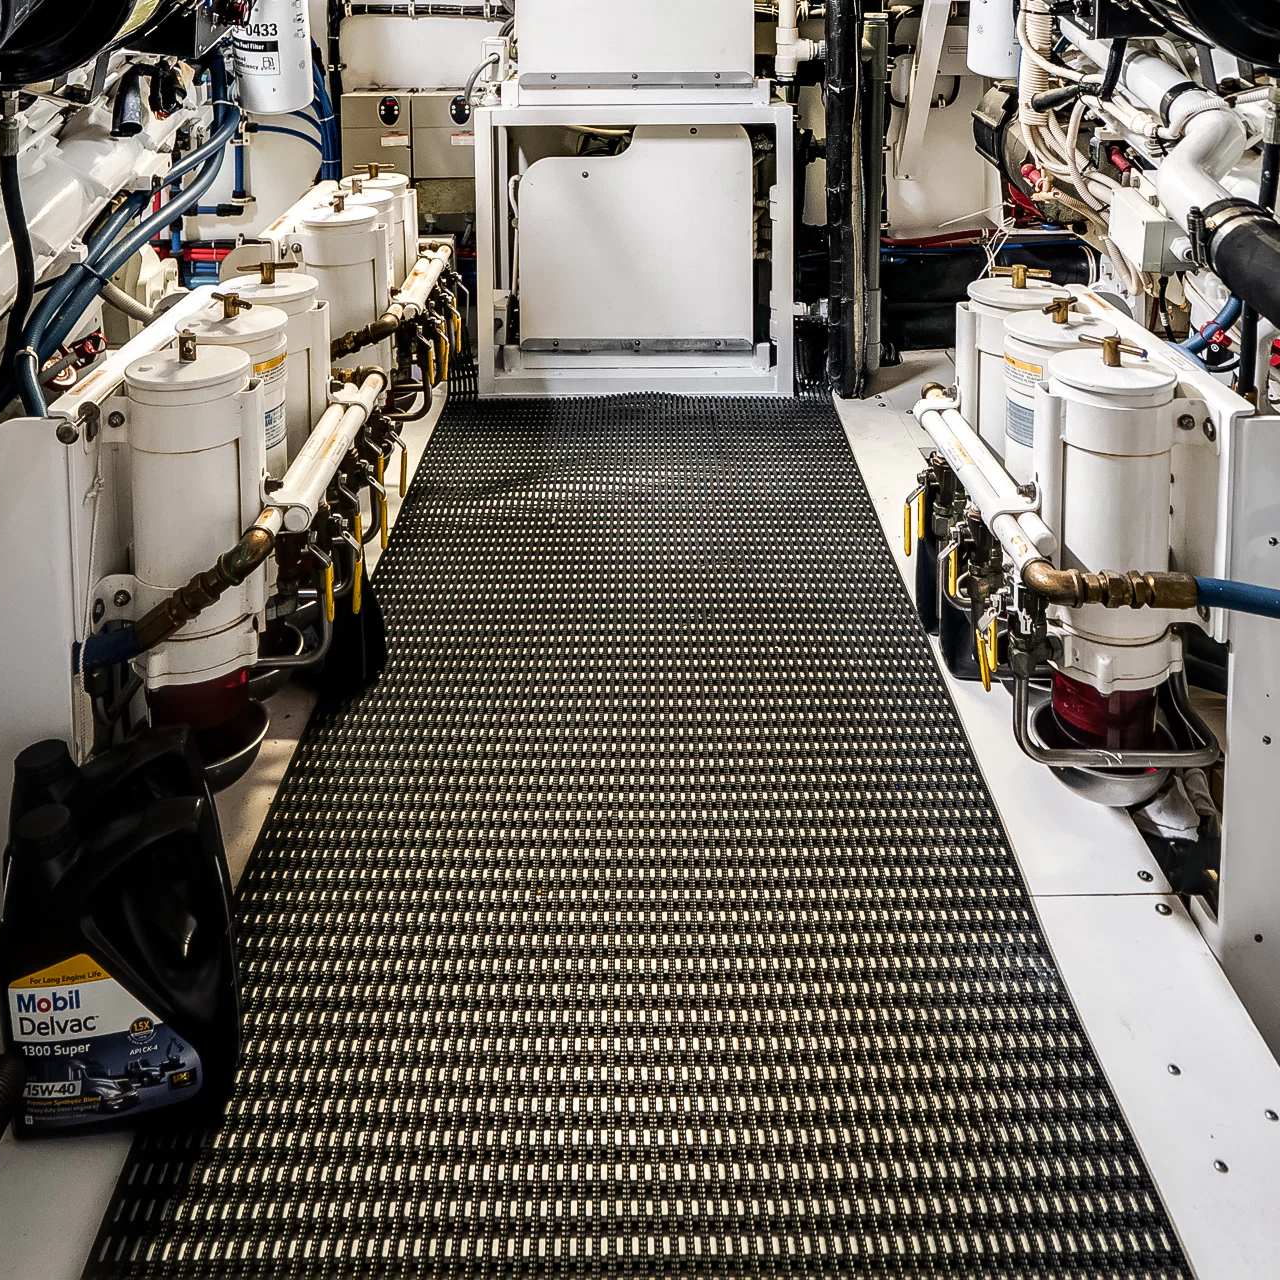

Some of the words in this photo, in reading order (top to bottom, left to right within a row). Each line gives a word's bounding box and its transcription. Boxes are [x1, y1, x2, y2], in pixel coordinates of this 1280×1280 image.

[30, 977, 42, 985] For
[42, 976, 61, 985] Long
[61, 973, 86, 984] Engine
[87, 970, 102, 979] Life
[17, 989, 81, 1013] Mobil
[22, 1045, 50, 1056] 1300
[54, 1043, 91, 1057] Super
[129, 1047, 142, 1056] API
[142, 1044, 158, 1054] CK-4
[25, 1082, 76, 1097] 15W-40
[53, 1097, 82, 1107] Synthetic
[83, 1095, 102, 1103] Blend
[27, 1107, 43, 1115] Heavy
[44, 1106, 57, 1115] duty
[72, 1104, 91, 1113] engine
